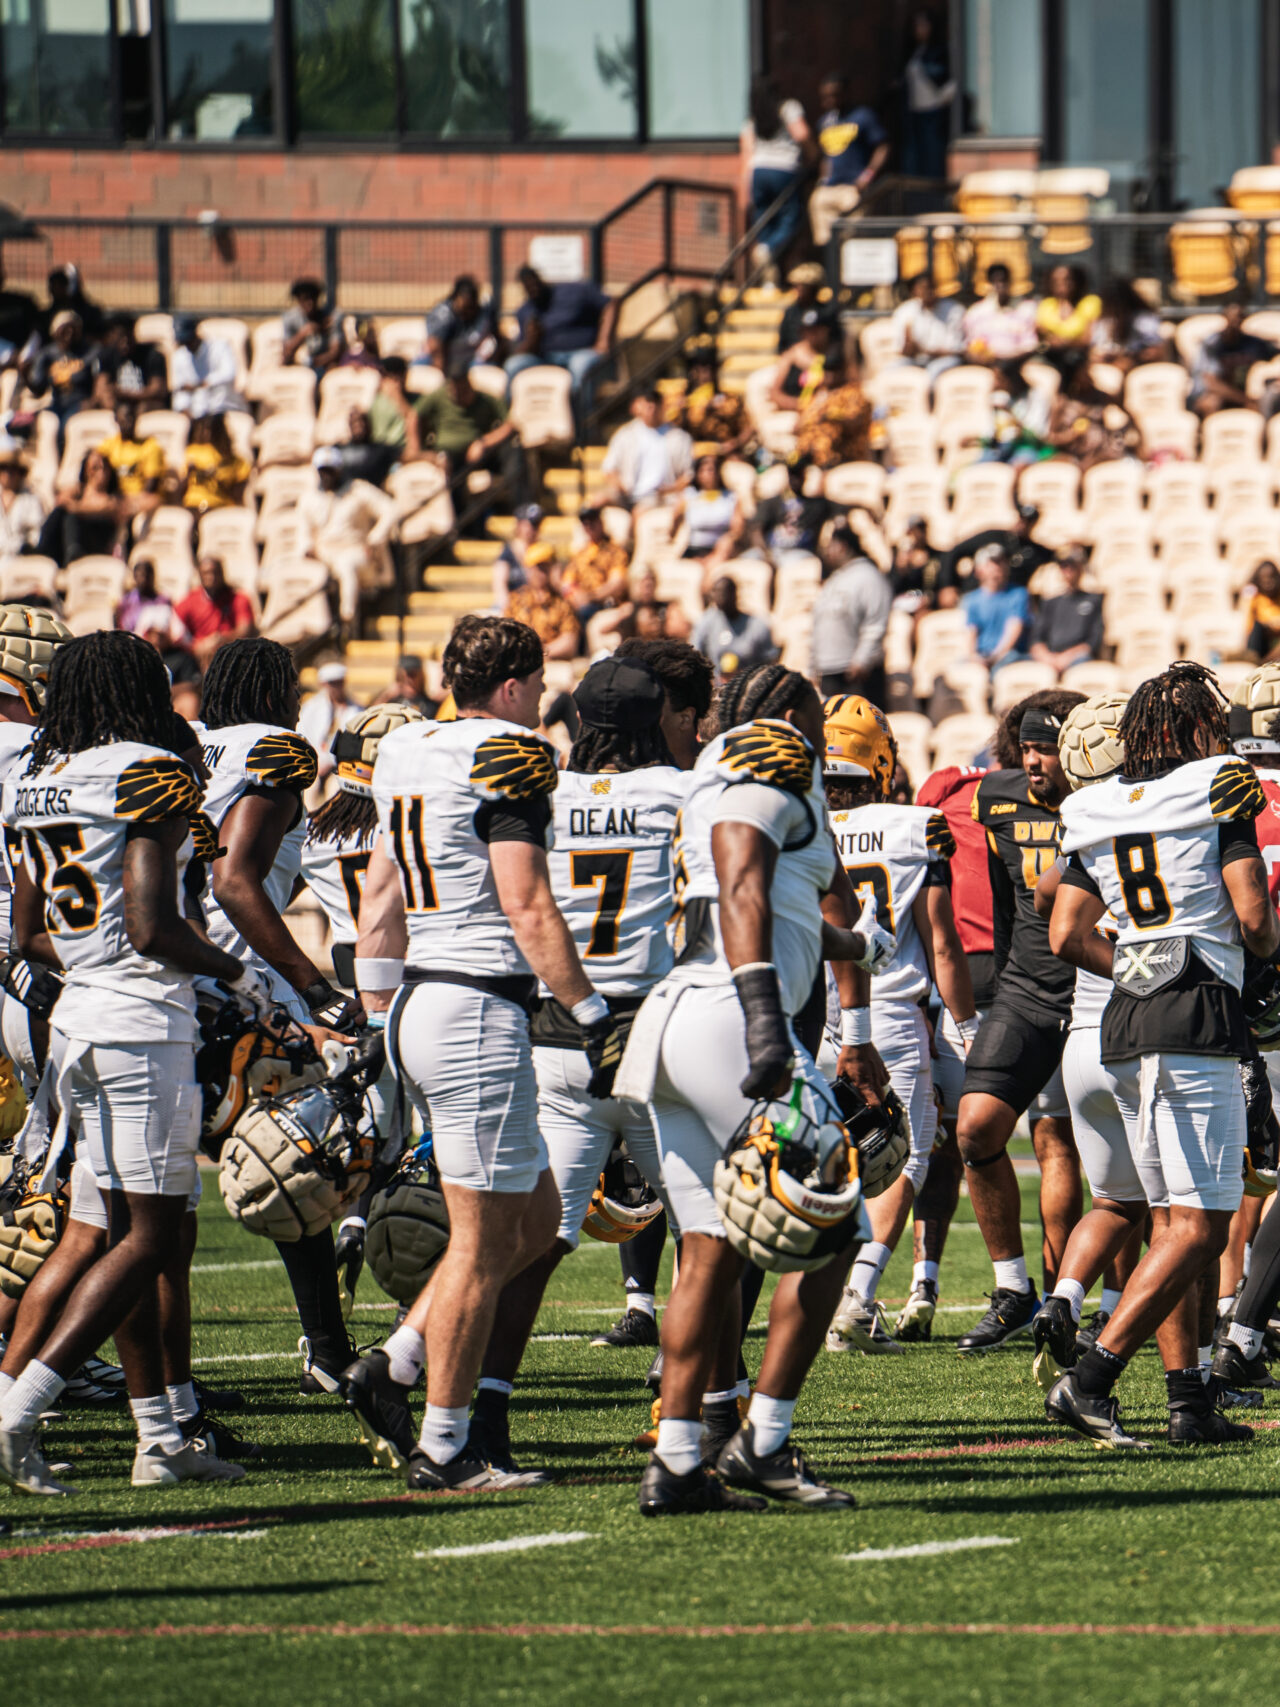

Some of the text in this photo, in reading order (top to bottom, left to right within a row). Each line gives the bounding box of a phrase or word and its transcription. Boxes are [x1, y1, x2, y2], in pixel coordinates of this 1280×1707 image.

[15, 787, 72, 817] ROGERS
[200, 744, 226, 768] ON
[390, 795, 439, 912] 11
[570, 808, 637, 836] DEAN
[20, 823, 103, 935] 15
[569, 849, 635, 958] 7
[1112, 832, 1175, 932] 8
